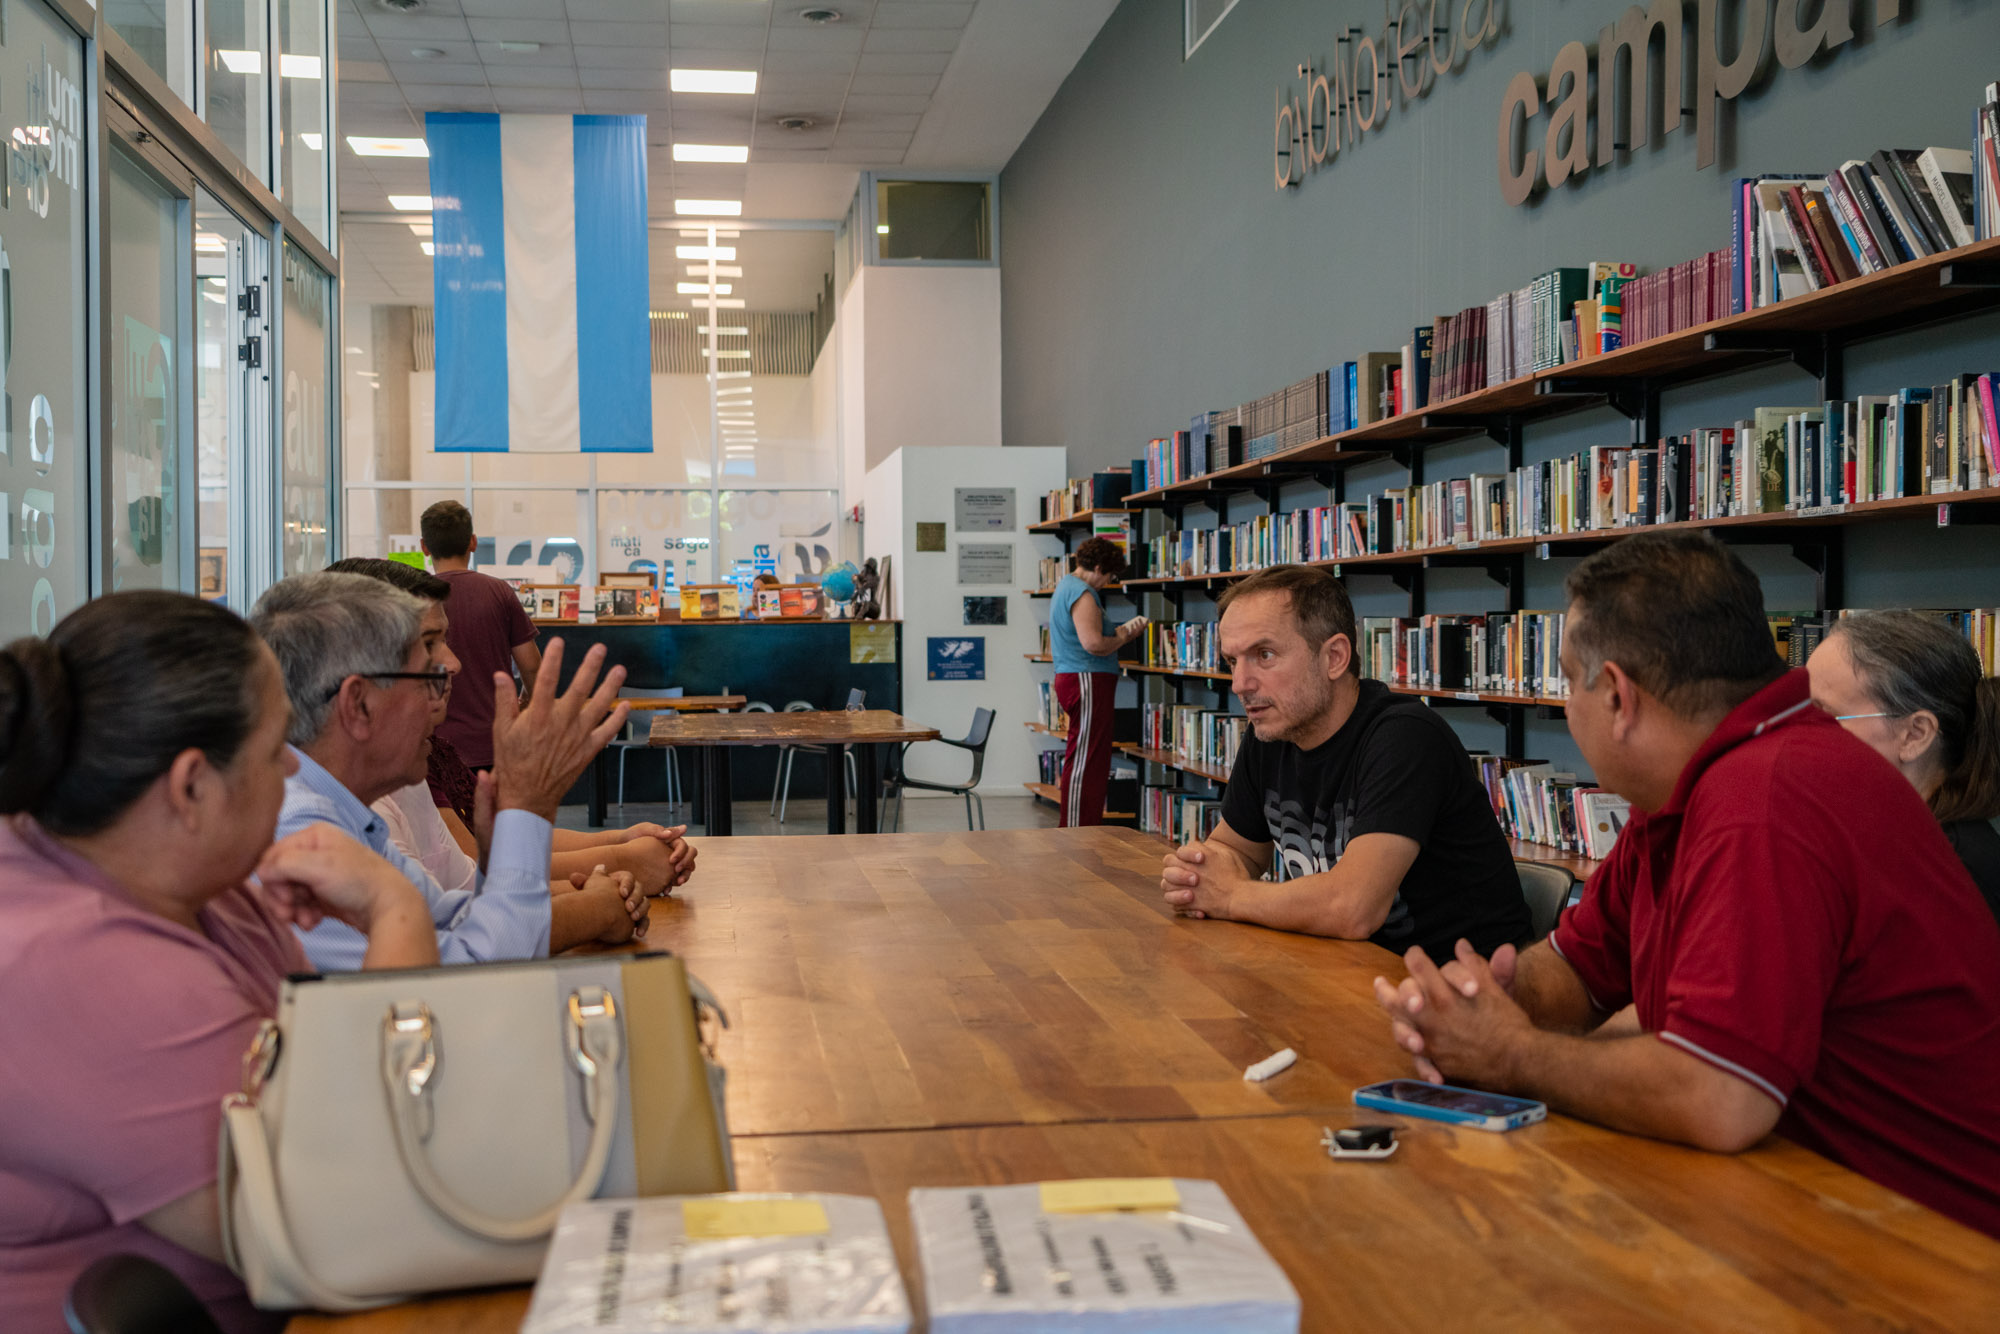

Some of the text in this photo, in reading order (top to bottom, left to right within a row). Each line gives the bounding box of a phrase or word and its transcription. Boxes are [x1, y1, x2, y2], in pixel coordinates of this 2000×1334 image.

[1274, 0, 1497, 192] biblioteca
[1498, 0, 1900, 207] campa
[664, 537, 709, 553] saga
